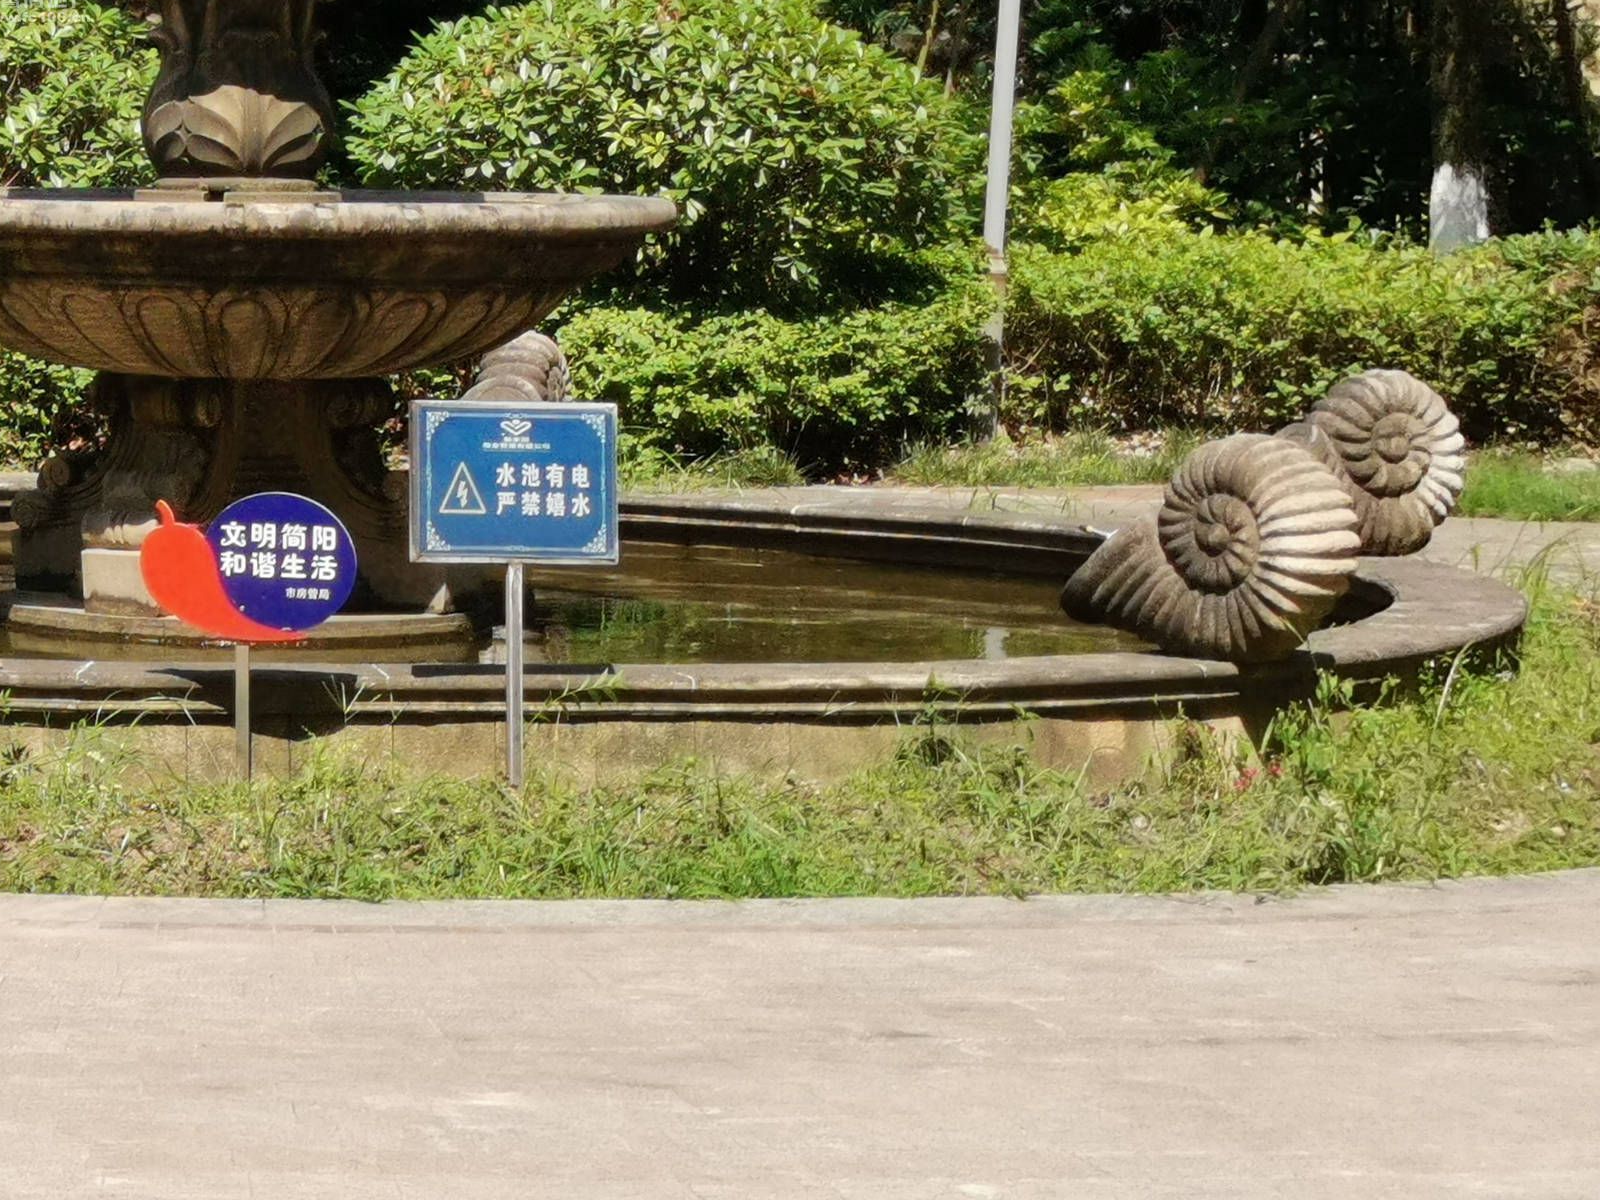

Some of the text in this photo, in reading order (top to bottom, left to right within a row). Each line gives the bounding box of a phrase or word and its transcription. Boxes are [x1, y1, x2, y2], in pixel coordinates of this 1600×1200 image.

[495, 462, 591, 489] 水池有电
[495, 491, 591, 518] 严禁嬉水
[219, 520, 337, 551] 文明简阳
[219, 550, 338, 581] 和谐生活
